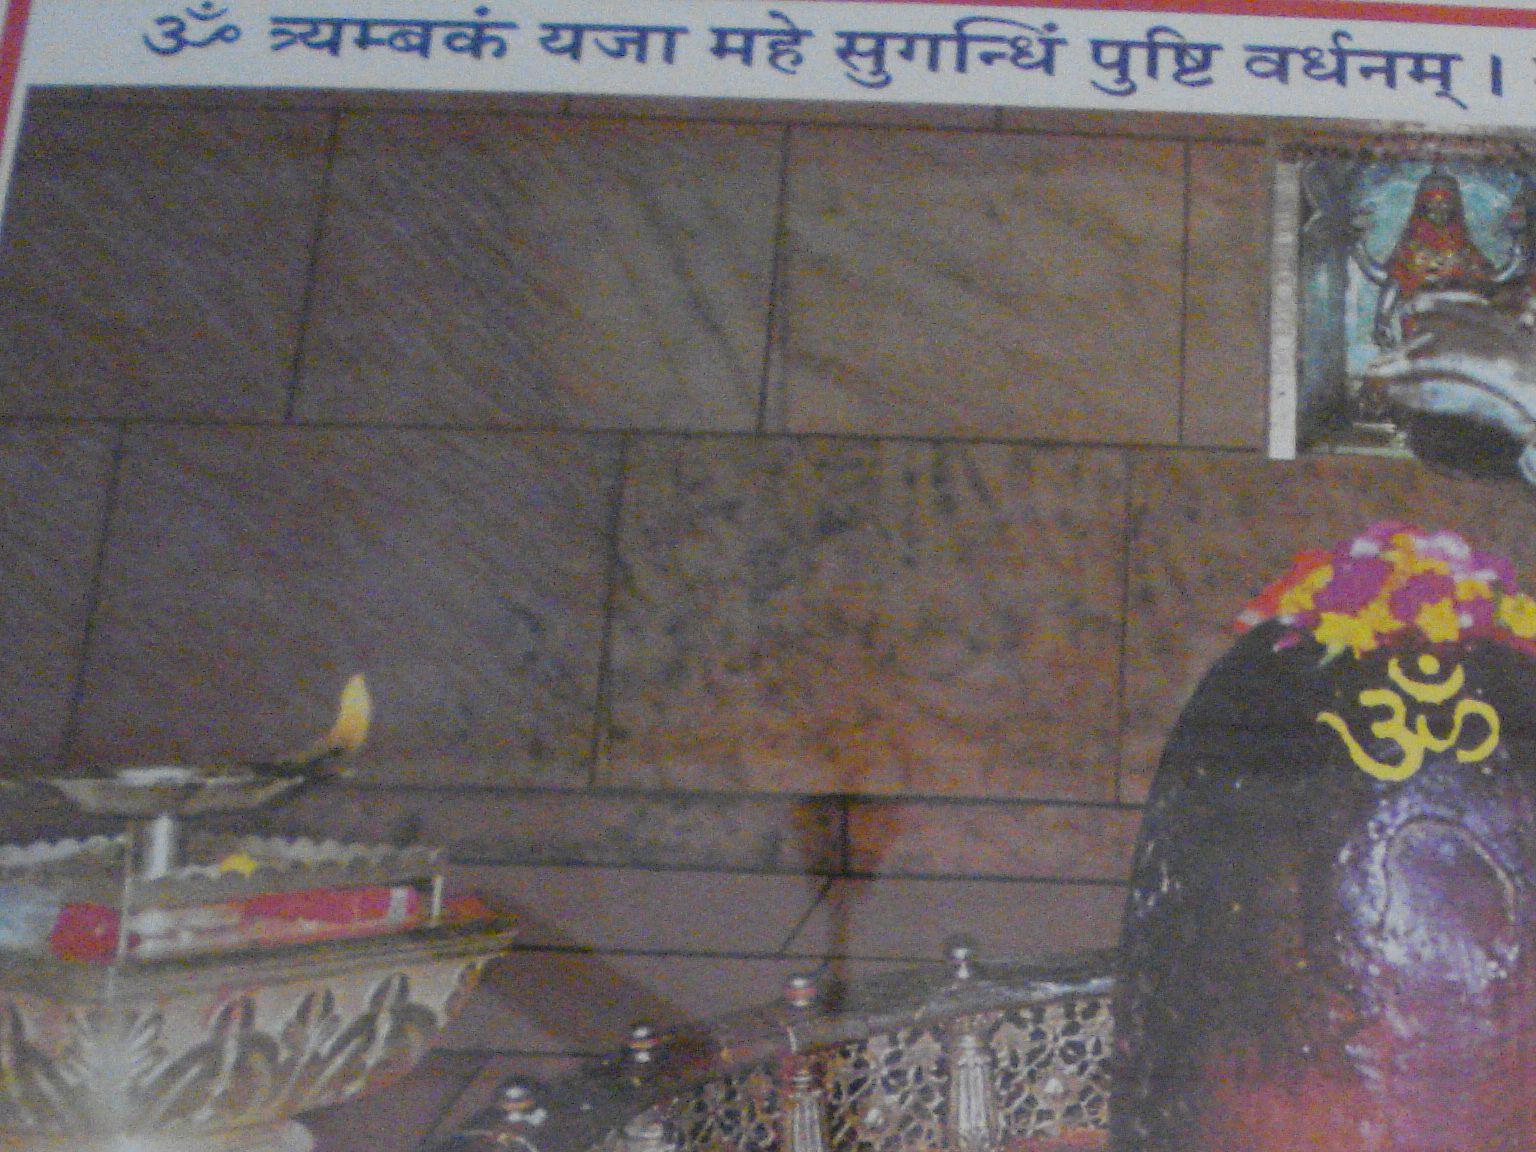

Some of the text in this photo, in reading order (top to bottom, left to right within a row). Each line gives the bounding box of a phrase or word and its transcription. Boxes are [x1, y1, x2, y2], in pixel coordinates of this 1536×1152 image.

[142, 0, 242, 56] ॐ
[538, 22, 690, 65] यजा
[709, 10, 814, 76] महे
[834, 15, 1068, 89] सुगन्धिं
[1087, 24, 1222, 97] पुष्टि
[1243, 29, 1470, 110] वर्धनम्
